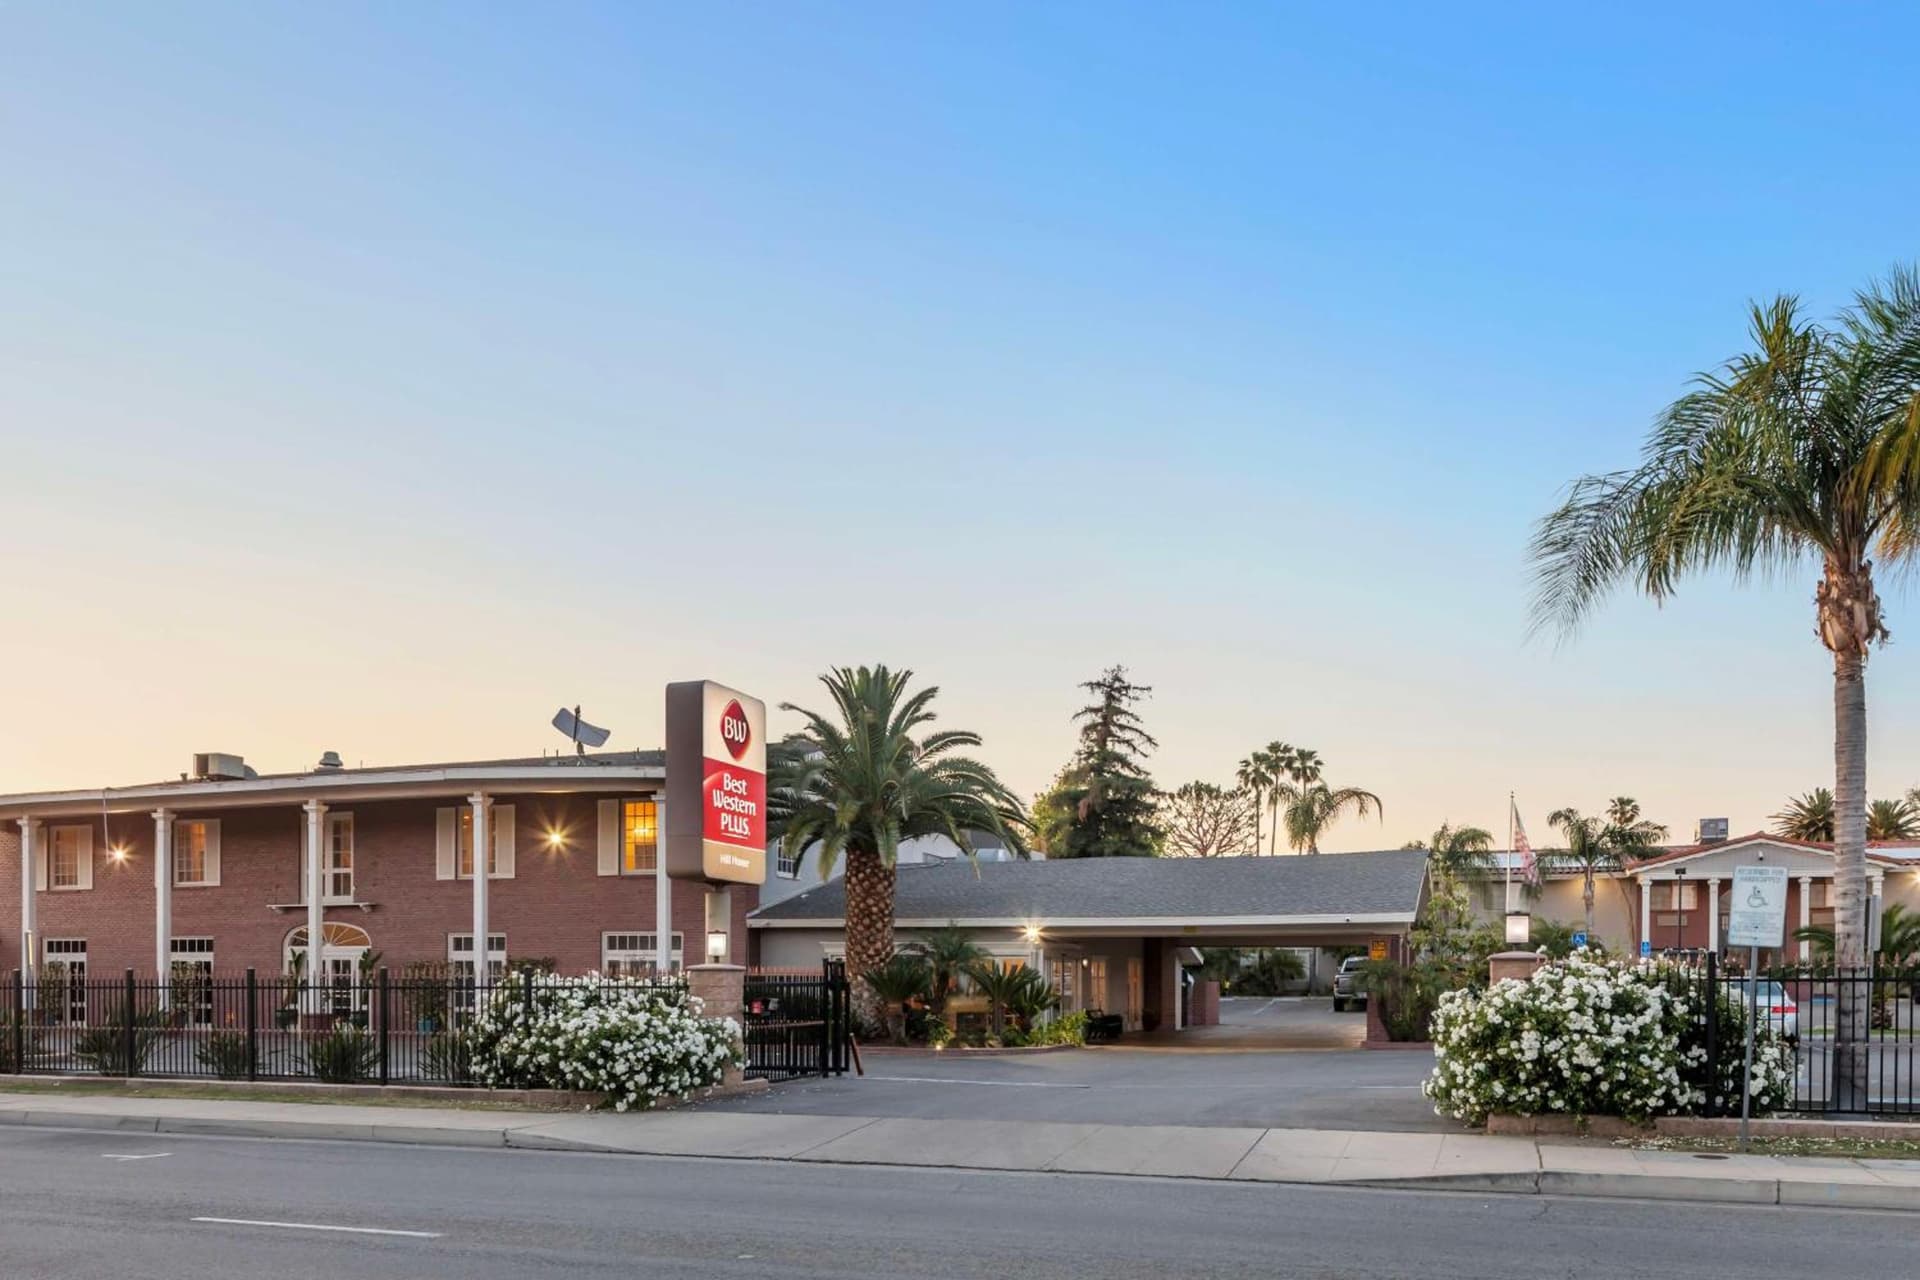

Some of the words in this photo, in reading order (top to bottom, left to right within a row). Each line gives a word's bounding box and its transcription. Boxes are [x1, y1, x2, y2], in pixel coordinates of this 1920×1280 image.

[724, 716, 747, 743] BW
[723, 773, 747, 796] Best
[713, 789, 756, 817] Western
